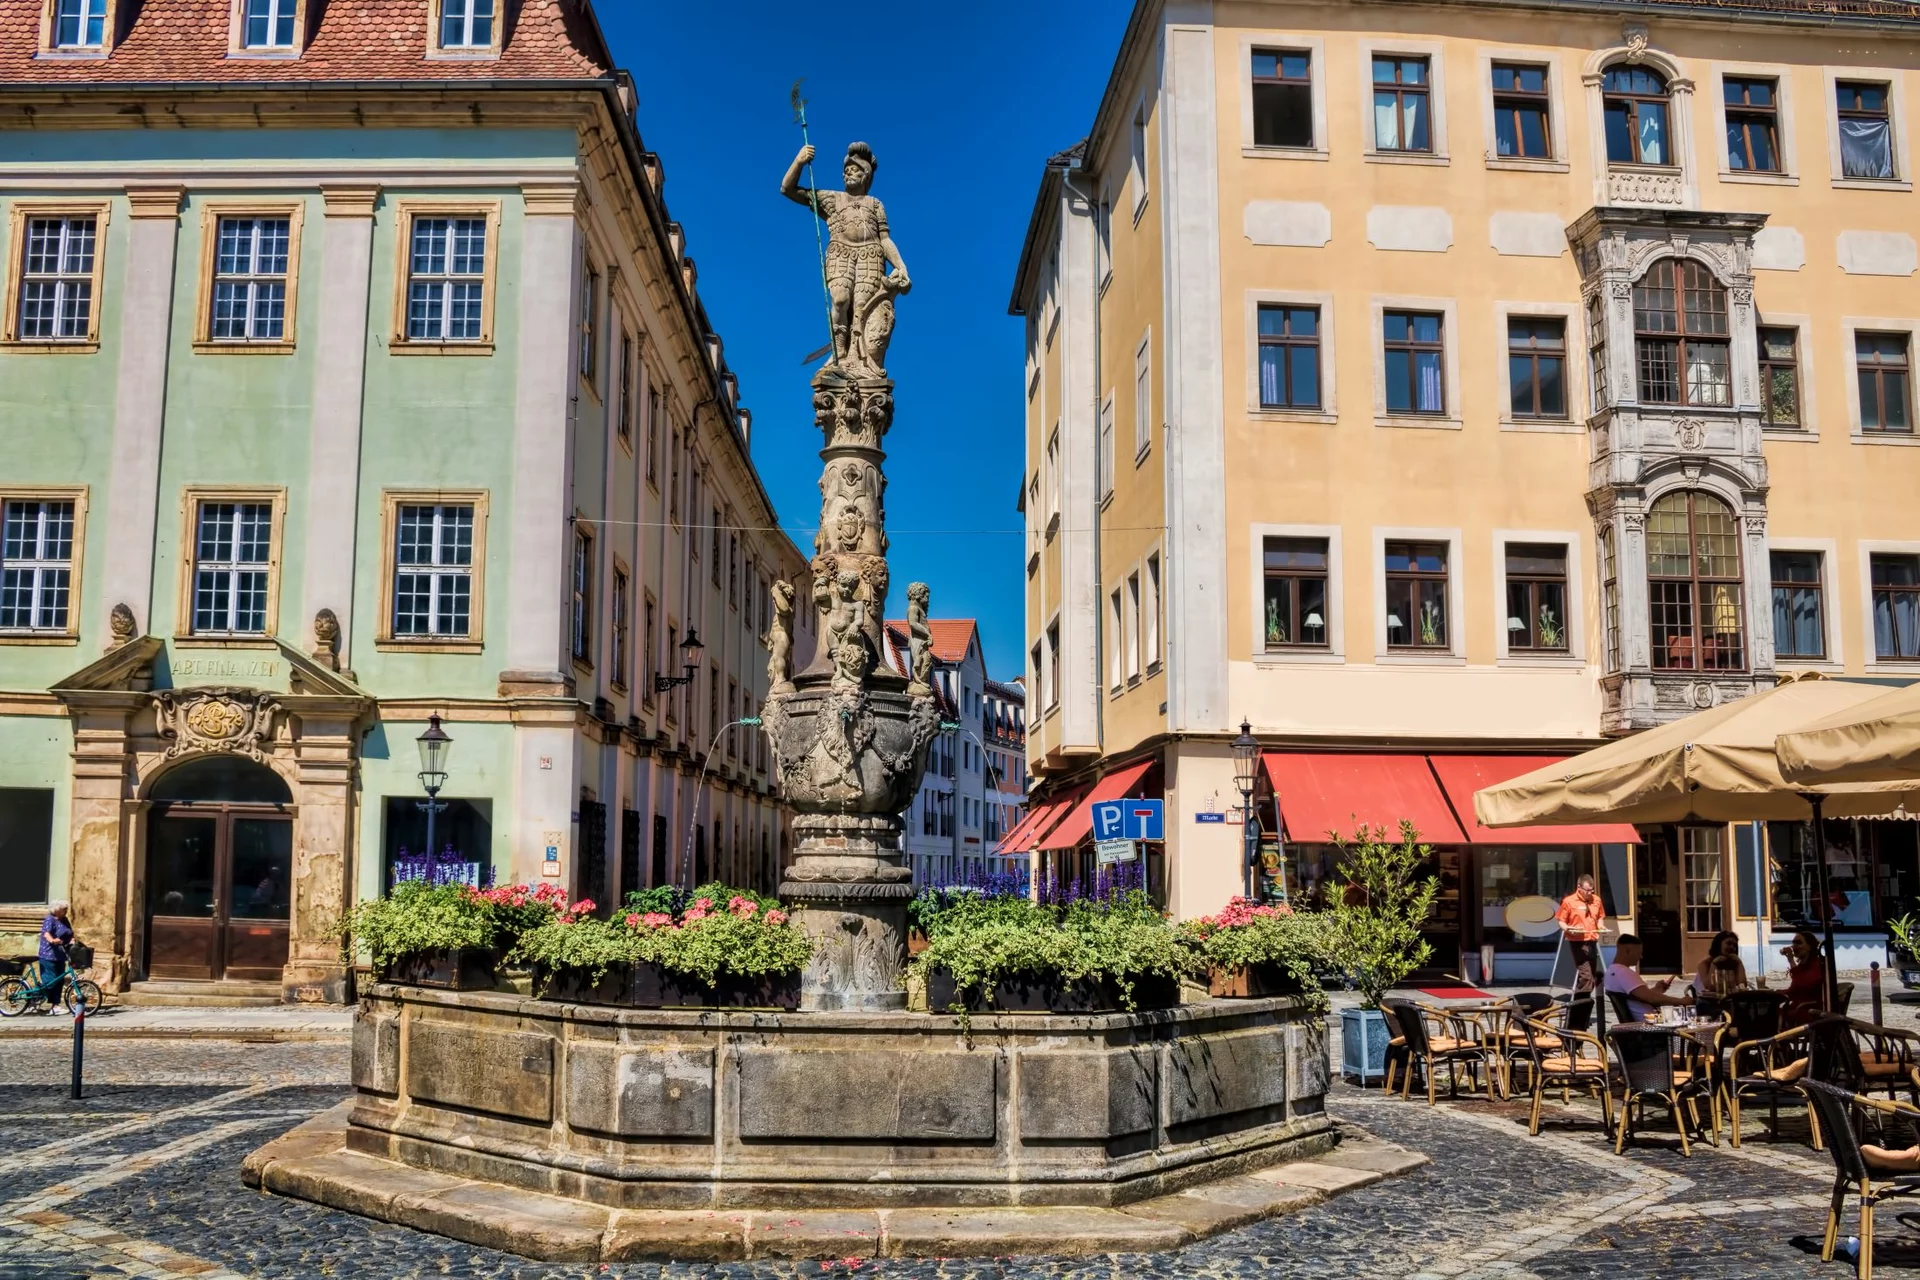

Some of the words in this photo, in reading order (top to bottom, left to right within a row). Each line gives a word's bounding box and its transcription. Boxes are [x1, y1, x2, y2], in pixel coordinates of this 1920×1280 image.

[205, 660, 281, 677] FINANZEN
[1100, 805, 1121, 836] P
[1101, 843, 1129, 851] Bewohner
